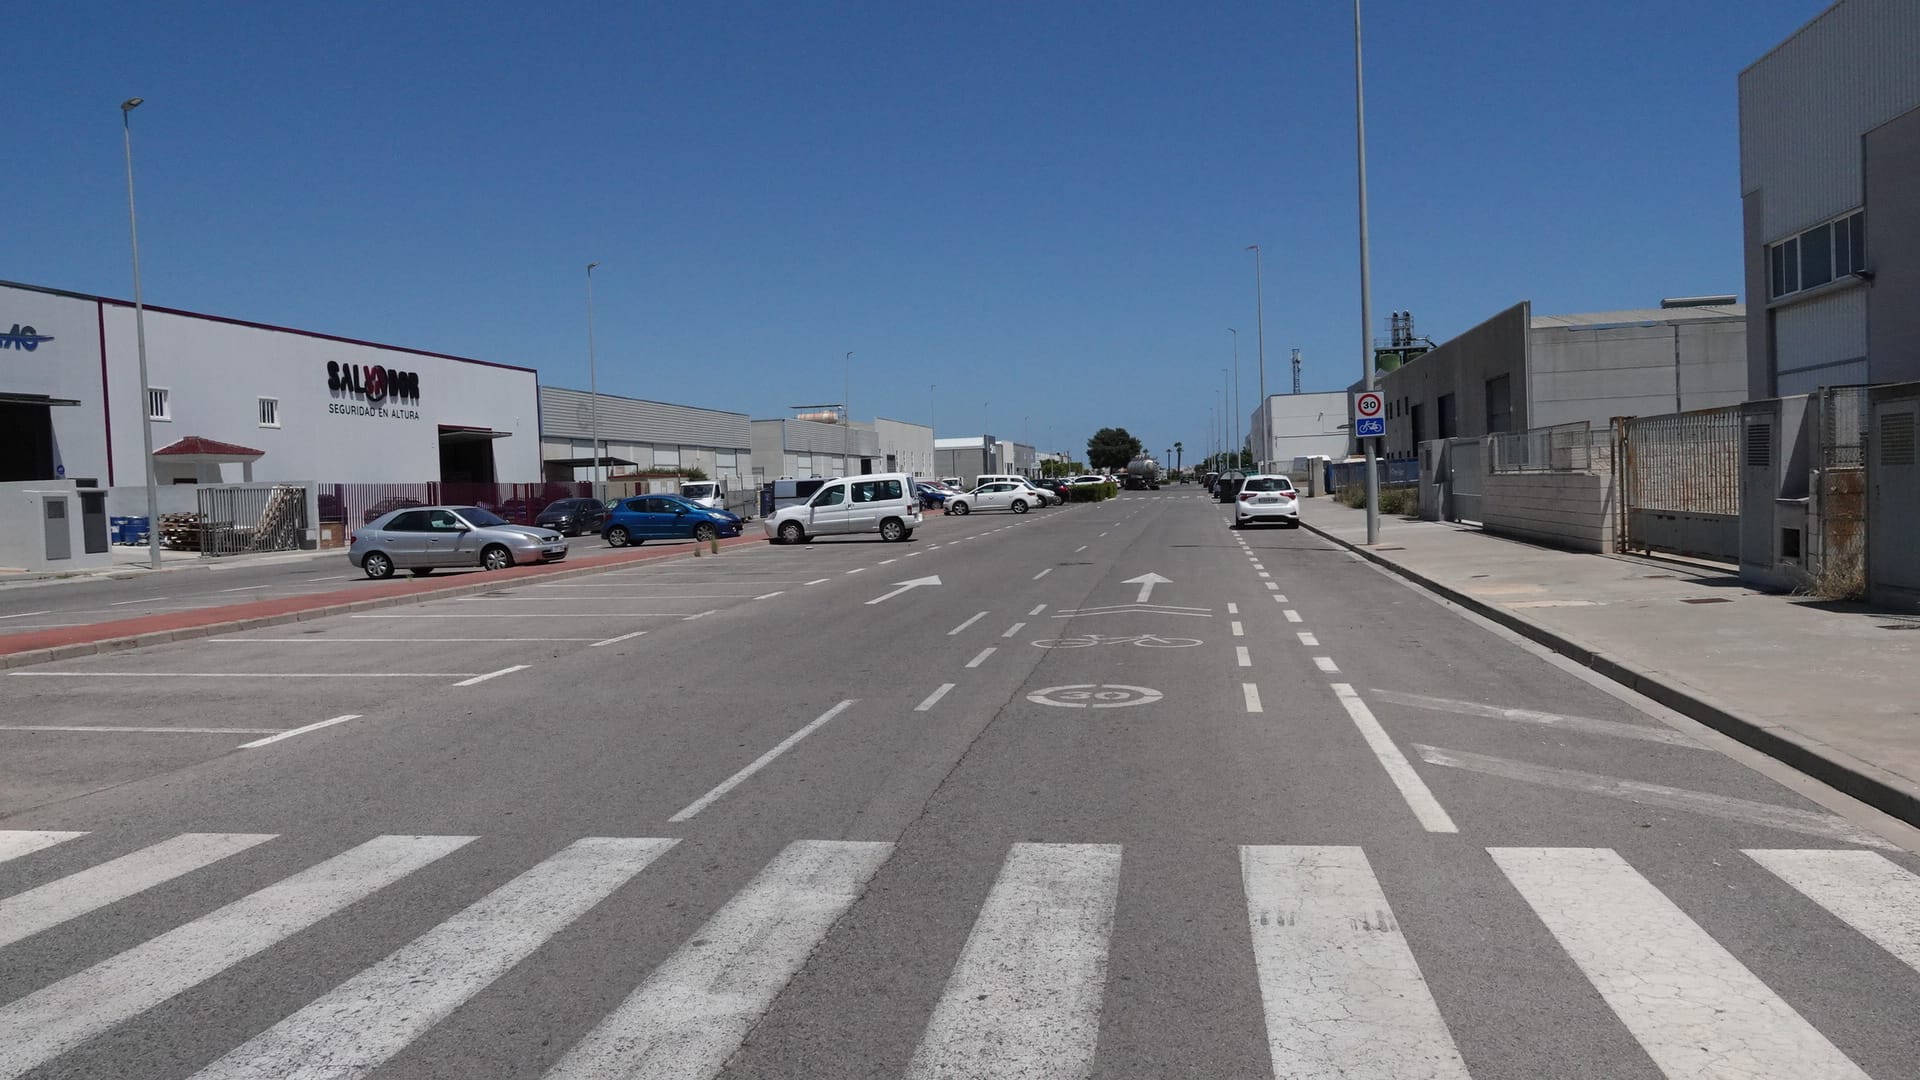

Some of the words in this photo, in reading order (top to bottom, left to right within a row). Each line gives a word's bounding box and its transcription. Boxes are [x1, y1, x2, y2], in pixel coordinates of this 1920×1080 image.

[1363, 401, 1376, 409] 30
[328, 403, 376, 417] SEGURIDAD
[378, 407, 389, 418] EN
[391, 409, 420, 420] ALTURA
[1060, 691, 1130, 700] 30
